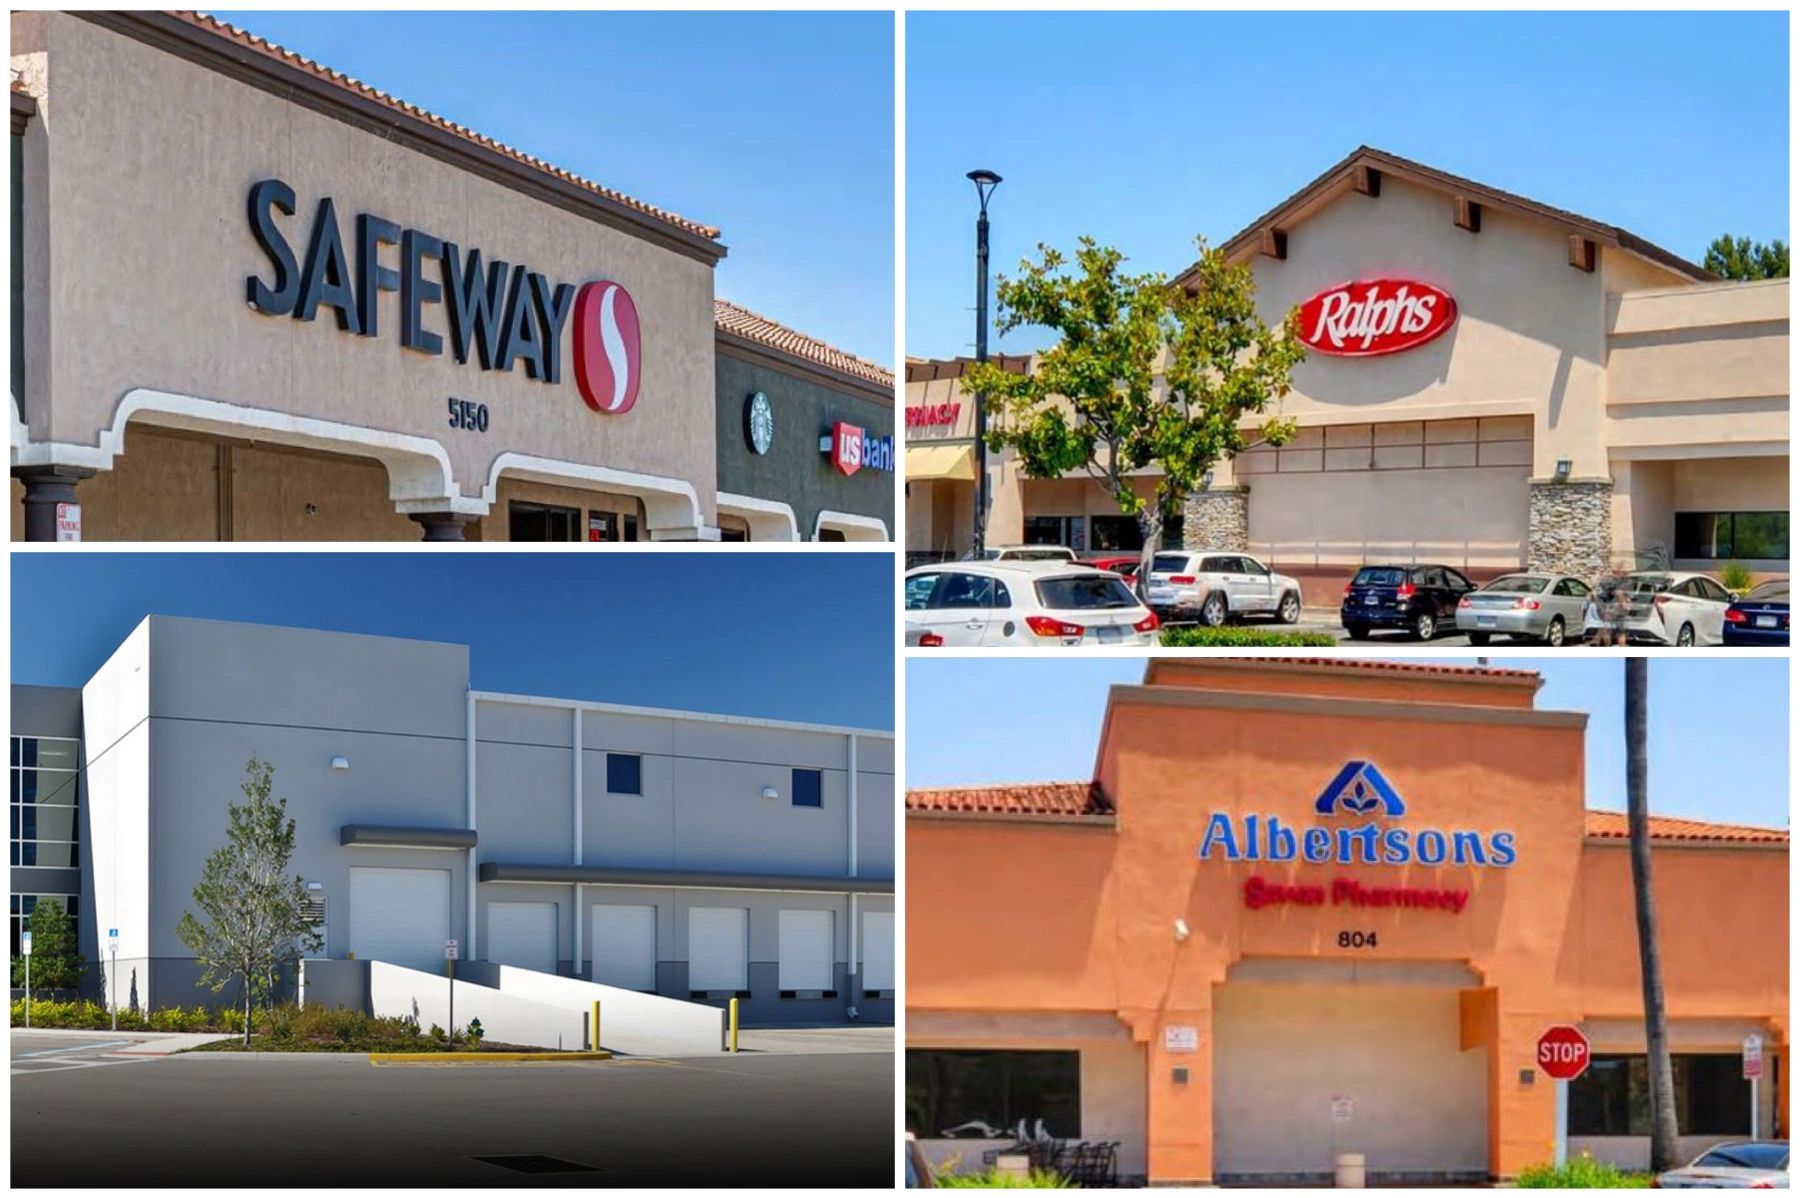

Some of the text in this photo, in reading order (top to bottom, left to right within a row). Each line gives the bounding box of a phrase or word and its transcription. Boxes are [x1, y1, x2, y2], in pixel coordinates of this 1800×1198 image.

[246, 179, 576, 384] SAFEWAY
[1309, 285, 1437, 350] Ralphs
[448, 397, 489, 432] 5150
[1199, 812, 1516, 867] Albertsons
[1332, 879, 1468, 914] Pharmacy
[1338, 931, 1378, 949] 804
[1540, 1042, 1585, 1063] STOP
